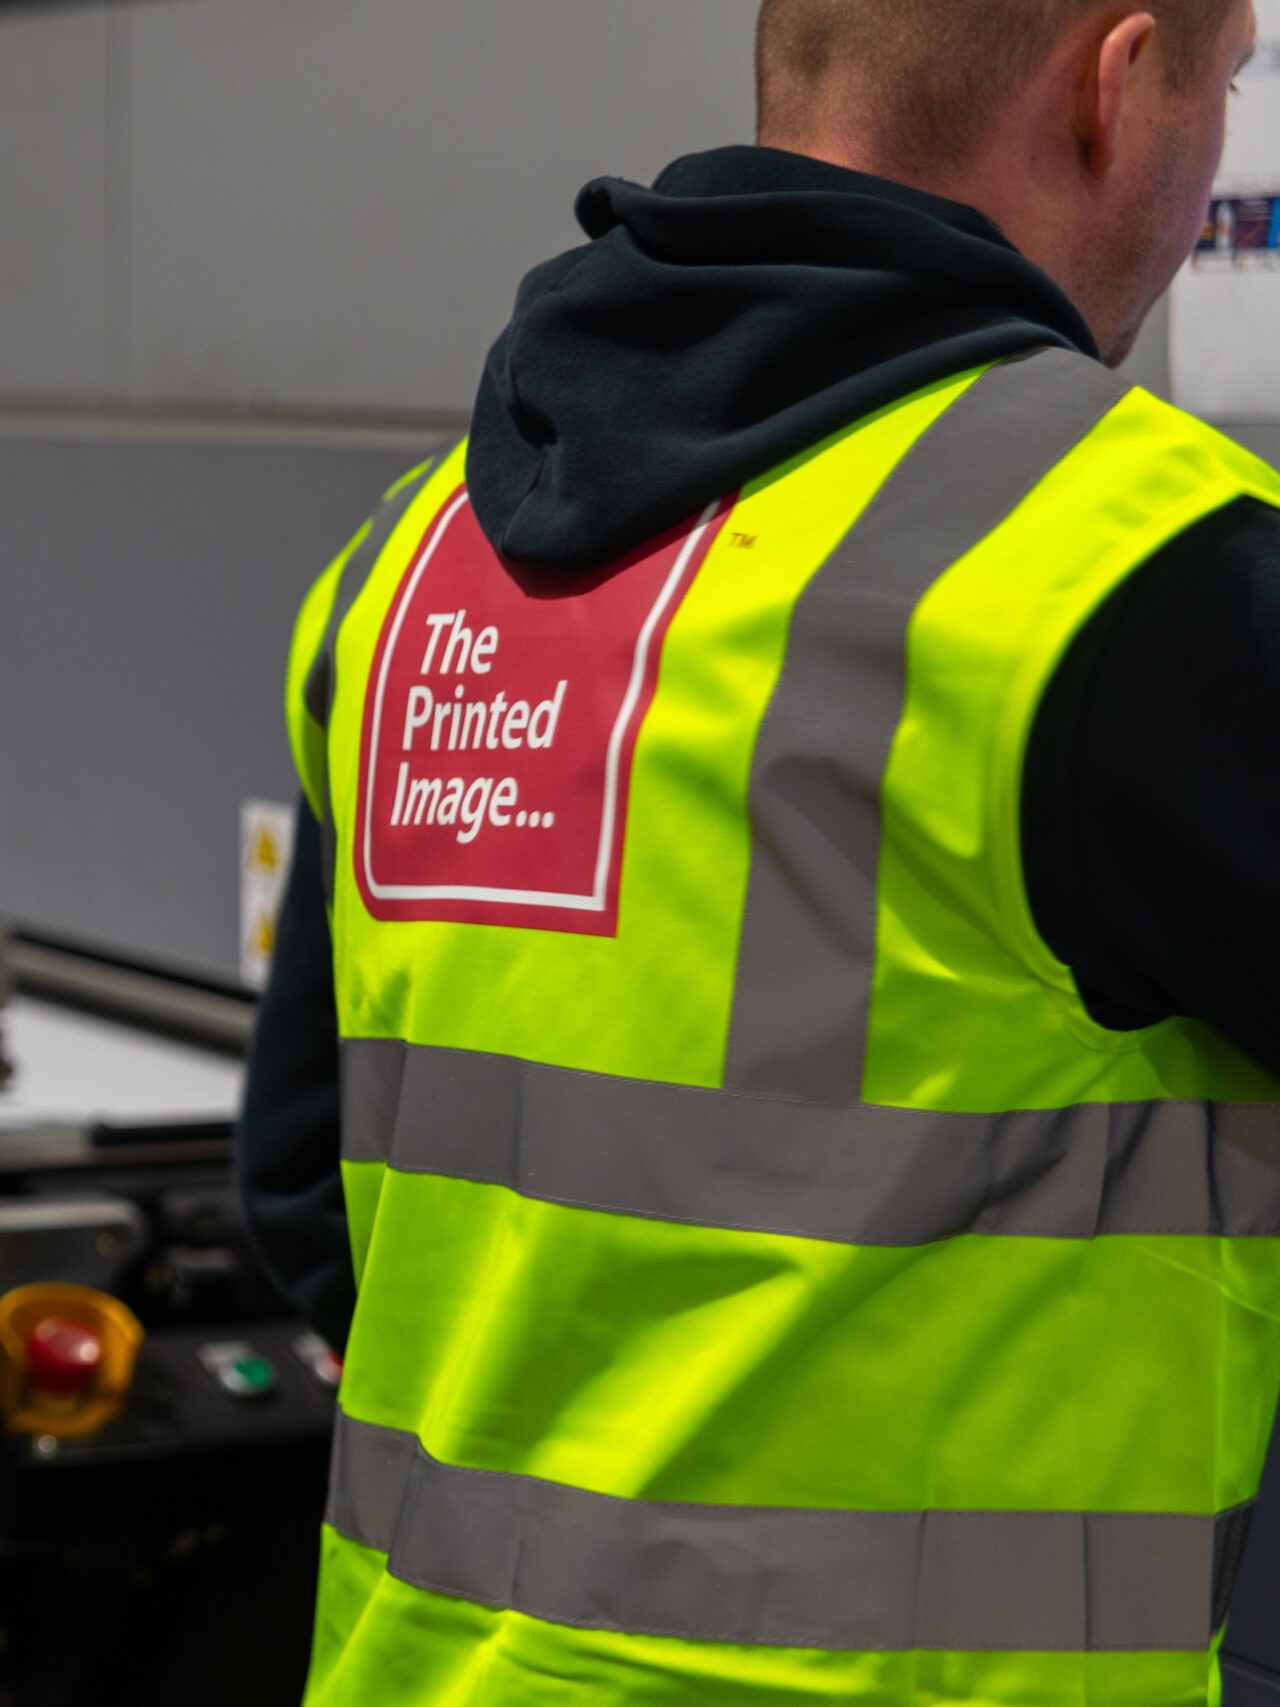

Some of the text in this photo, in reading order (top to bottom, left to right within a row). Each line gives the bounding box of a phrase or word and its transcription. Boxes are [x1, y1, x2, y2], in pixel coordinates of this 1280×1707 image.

[728, 532, 758, 549] TM
[420, 608, 499, 675] The
[402, 679, 568, 751] Printed
[389, 761, 555, 844] Image...
